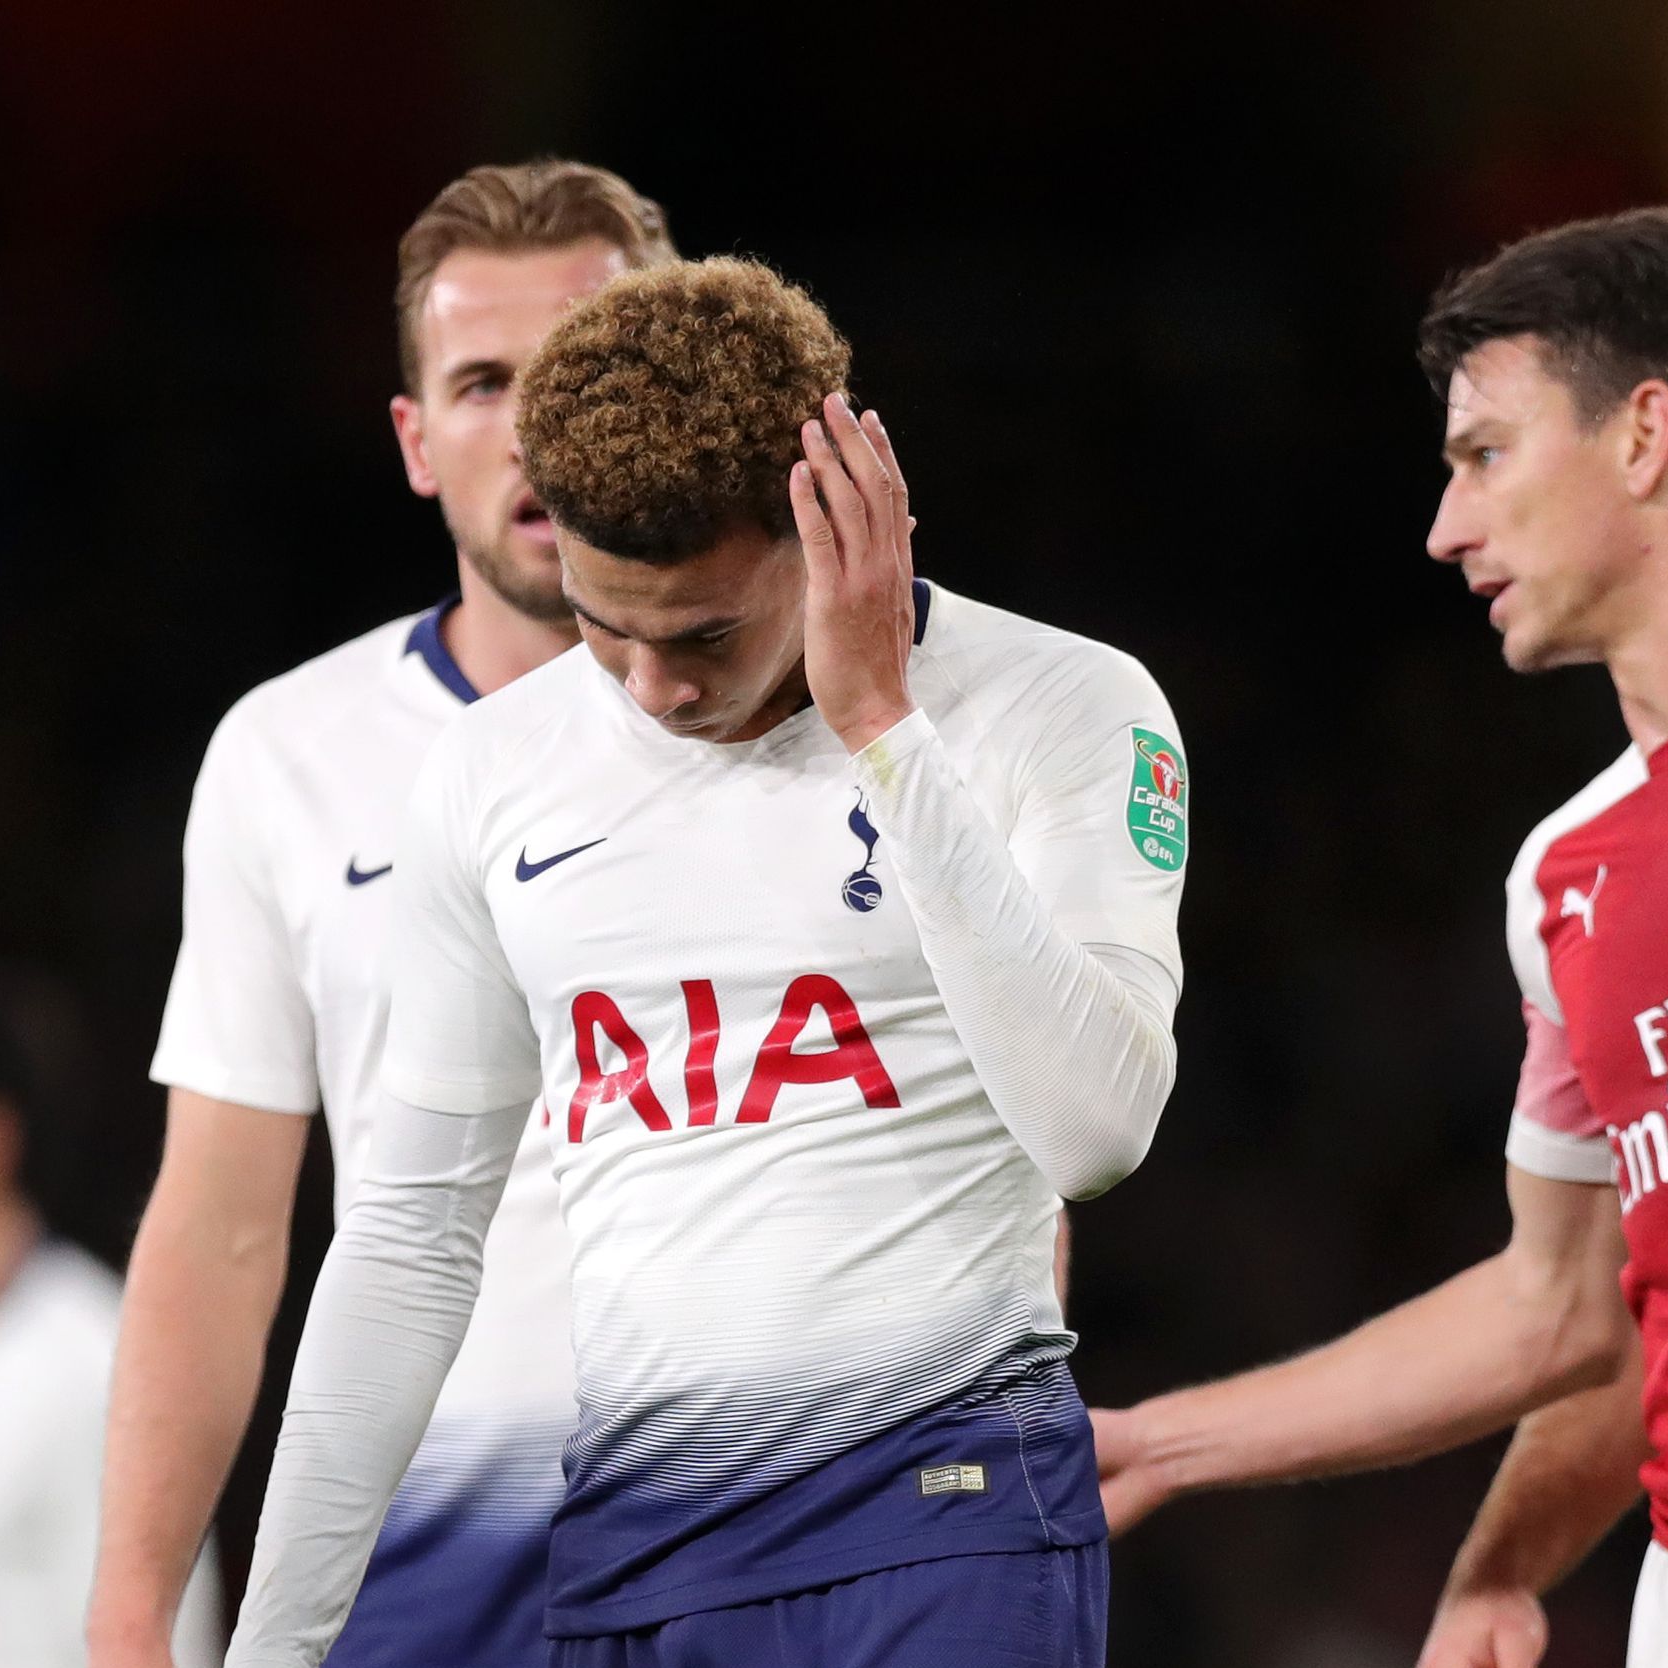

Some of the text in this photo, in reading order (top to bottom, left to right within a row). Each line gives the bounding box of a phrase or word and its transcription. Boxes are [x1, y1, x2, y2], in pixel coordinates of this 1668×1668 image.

[1149, 808, 1176, 834] Cup
[1158, 846, 1175, 866] EFL
[567, 974, 902, 1144] AIA
